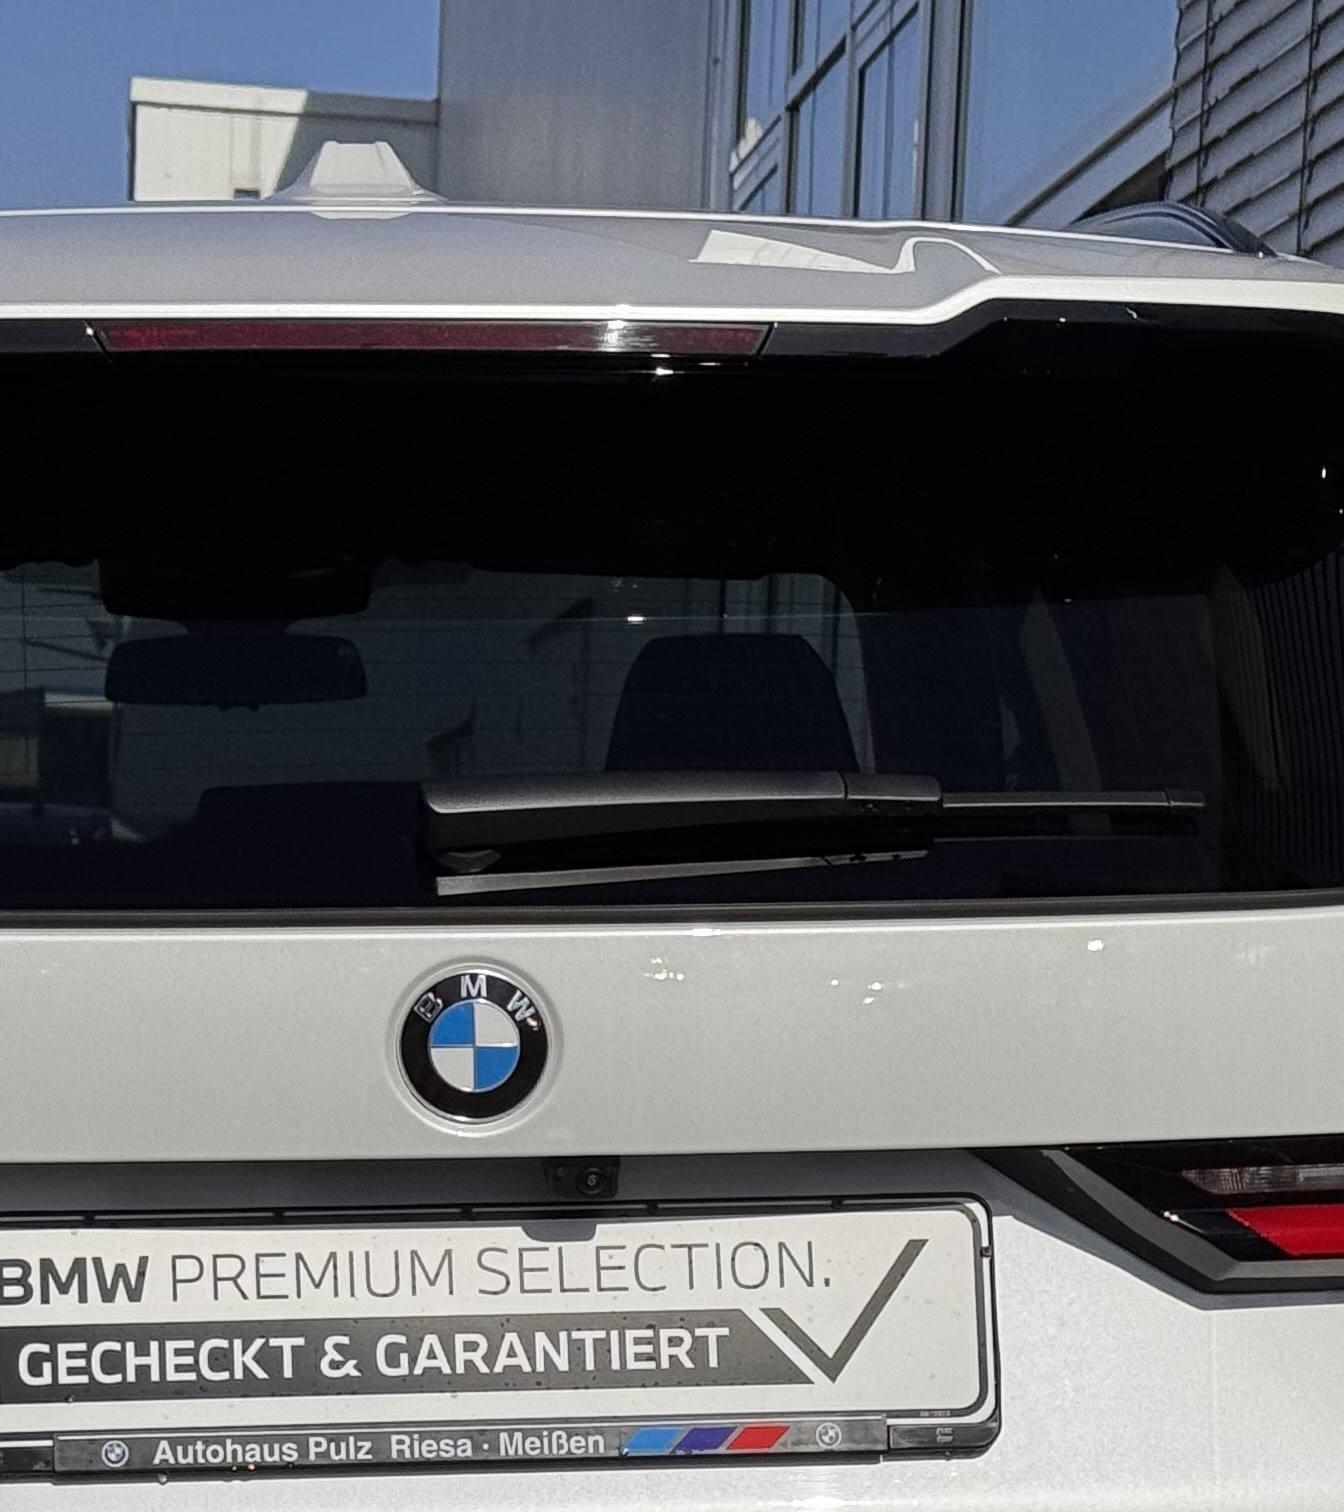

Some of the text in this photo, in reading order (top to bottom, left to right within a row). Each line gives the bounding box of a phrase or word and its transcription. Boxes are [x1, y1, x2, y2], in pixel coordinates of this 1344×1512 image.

[413, 974, 541, 1030] BMW
[171, 1248, 455, 1303] PREMIUM
[476, 1240, 832, 1297] SELECTION.
[17, 1326, 730, 1387] GECHECKT & GARANTIERT
[153, 1430, 605, 1465] Autohaus Pulz Riesa Meißen
